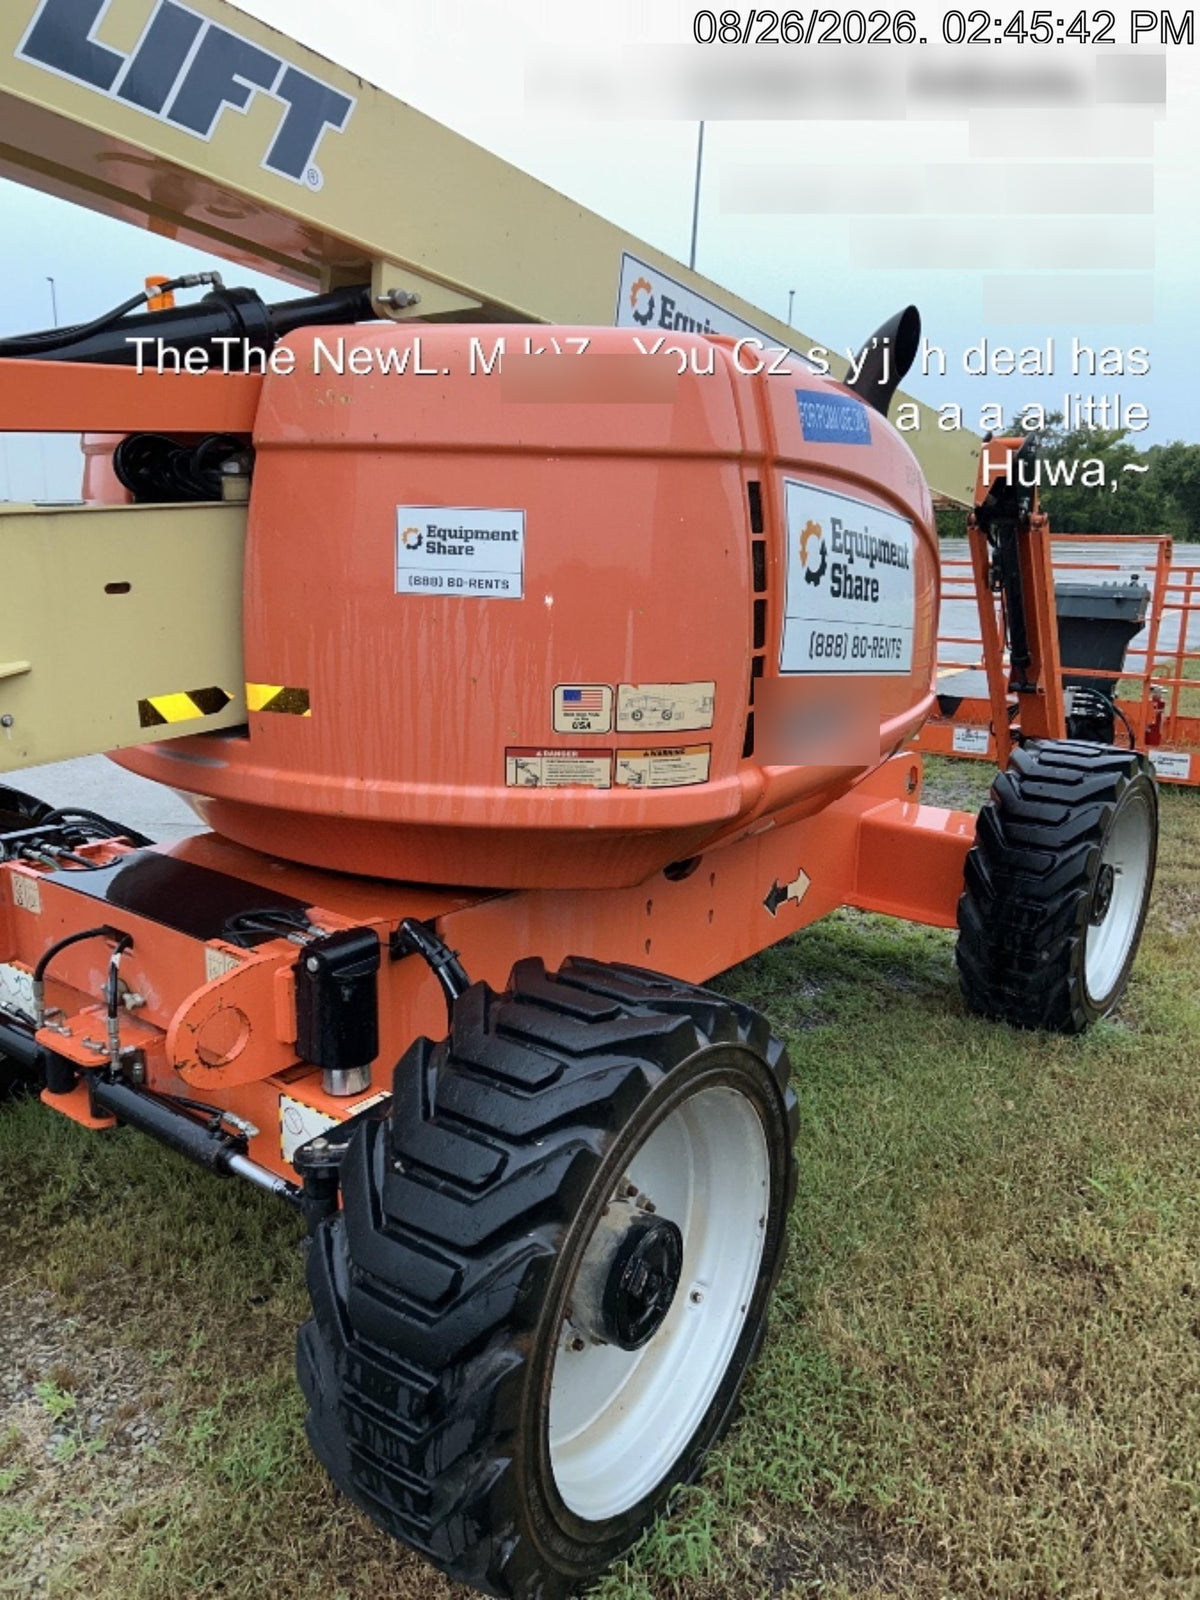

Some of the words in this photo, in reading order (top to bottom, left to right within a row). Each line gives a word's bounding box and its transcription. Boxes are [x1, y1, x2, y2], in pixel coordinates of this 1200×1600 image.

[426, 524, 519, 542] Equipment
[830, 517, 909, 570] Equipment
[426, 541, 475, 556] Share
[408, 575, 443, 588] (888)
[830, 563, 880, 603] Share
[809, 630, 849, 660] (888)
[851, 634, 903, 660] 80-RENTS
